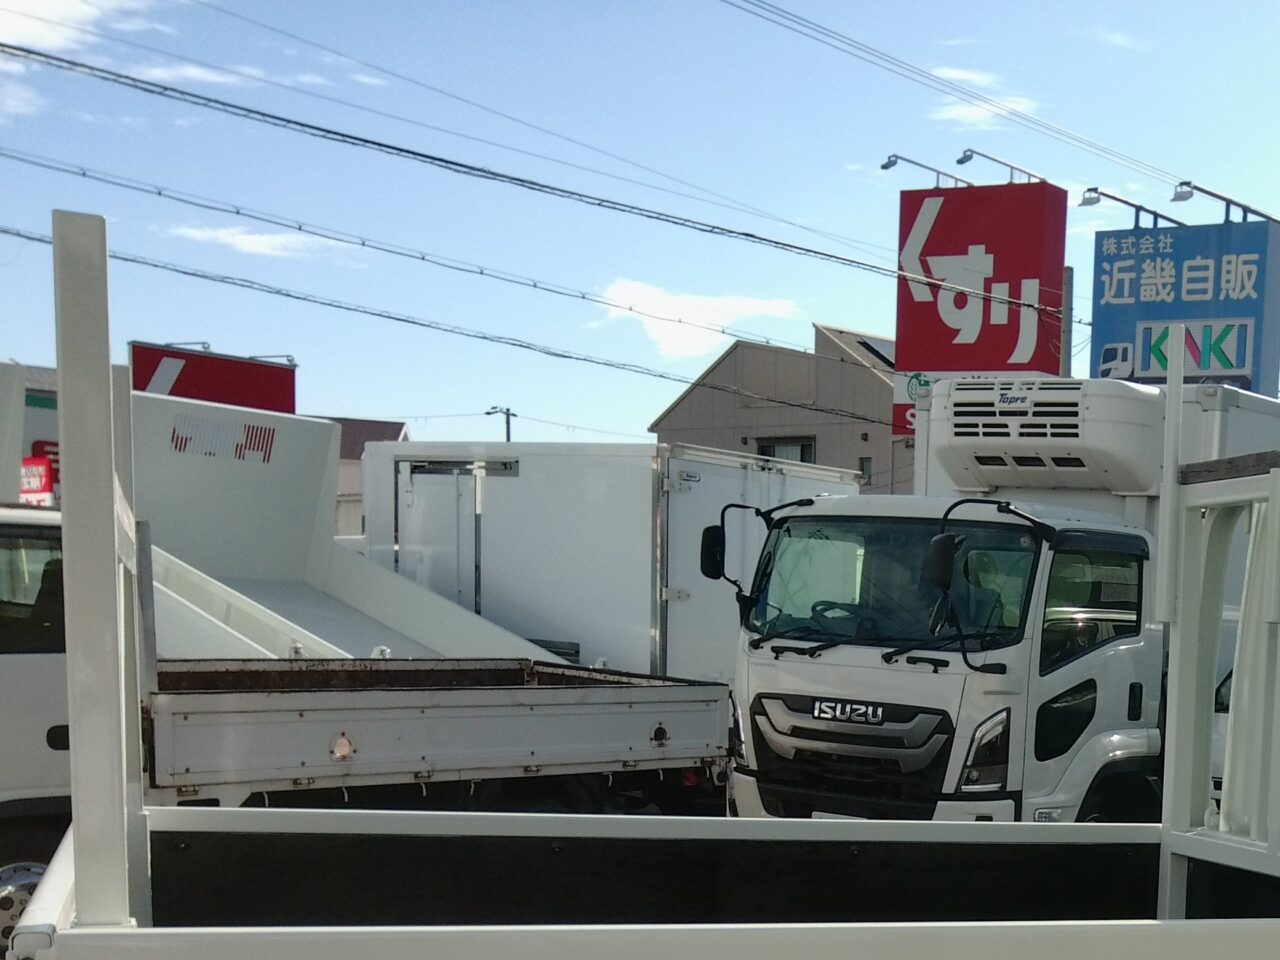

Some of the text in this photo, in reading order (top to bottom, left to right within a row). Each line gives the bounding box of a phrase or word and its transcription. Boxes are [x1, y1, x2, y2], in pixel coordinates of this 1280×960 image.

[1102, 233, 1174, 256] 株式会社
[900, 197, 1040, 364] くすり
[1100, 254, 1260, 305] 近畿自販
[998, 393, 1028, 404] Topre
[813, 701, 883, 723] ISUZU
